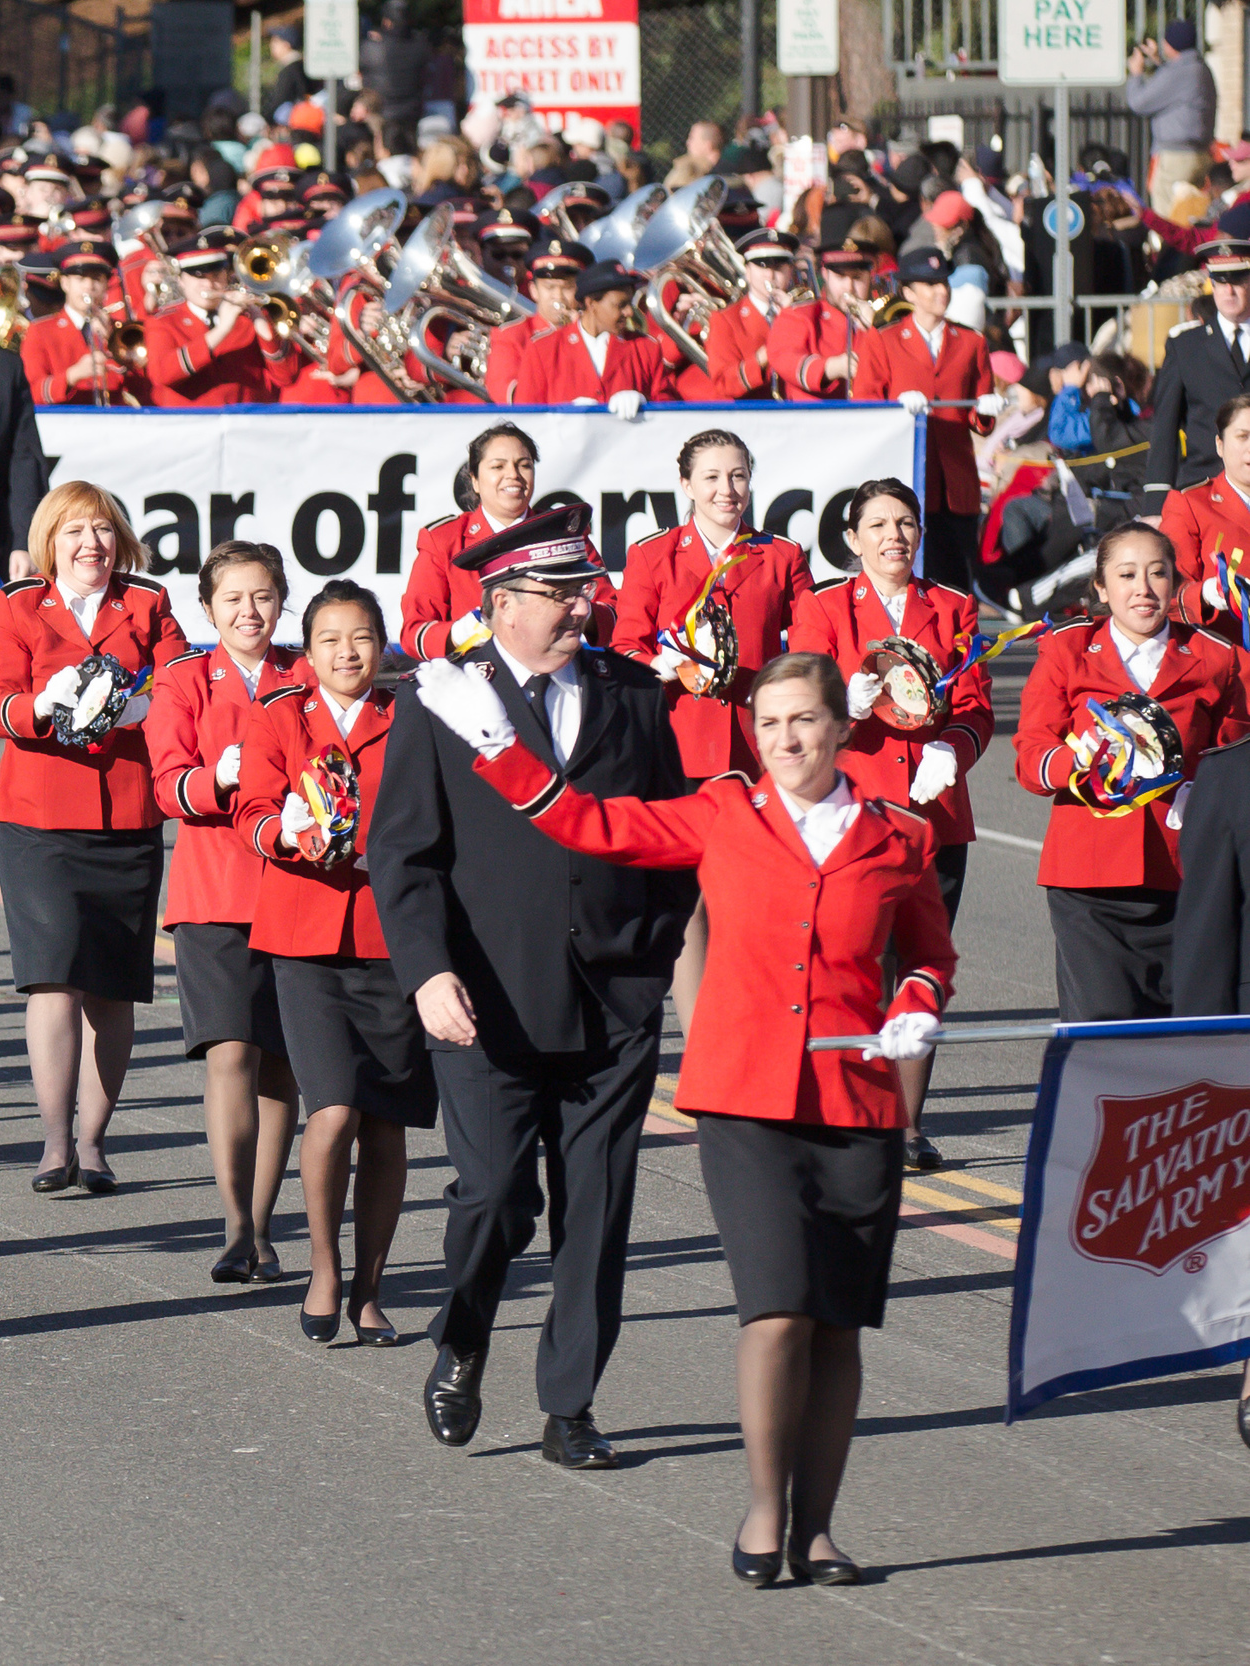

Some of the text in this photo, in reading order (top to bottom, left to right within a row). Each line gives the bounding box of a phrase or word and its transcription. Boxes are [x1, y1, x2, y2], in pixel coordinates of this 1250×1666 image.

[1034, 0, 1092, 21] PAY
[485, 36, 618, 59] ACCESS BY
[1023, 24, 1102, 48] HERE
[479, 69, 627, 95] TICKET ONLY
[291, 452, 418, 577] of
[528, 546, 551, 560] THE
[1123, 1091, 1210, 1163] THE
[1136, 1155, 1250, 1256] ARMY
